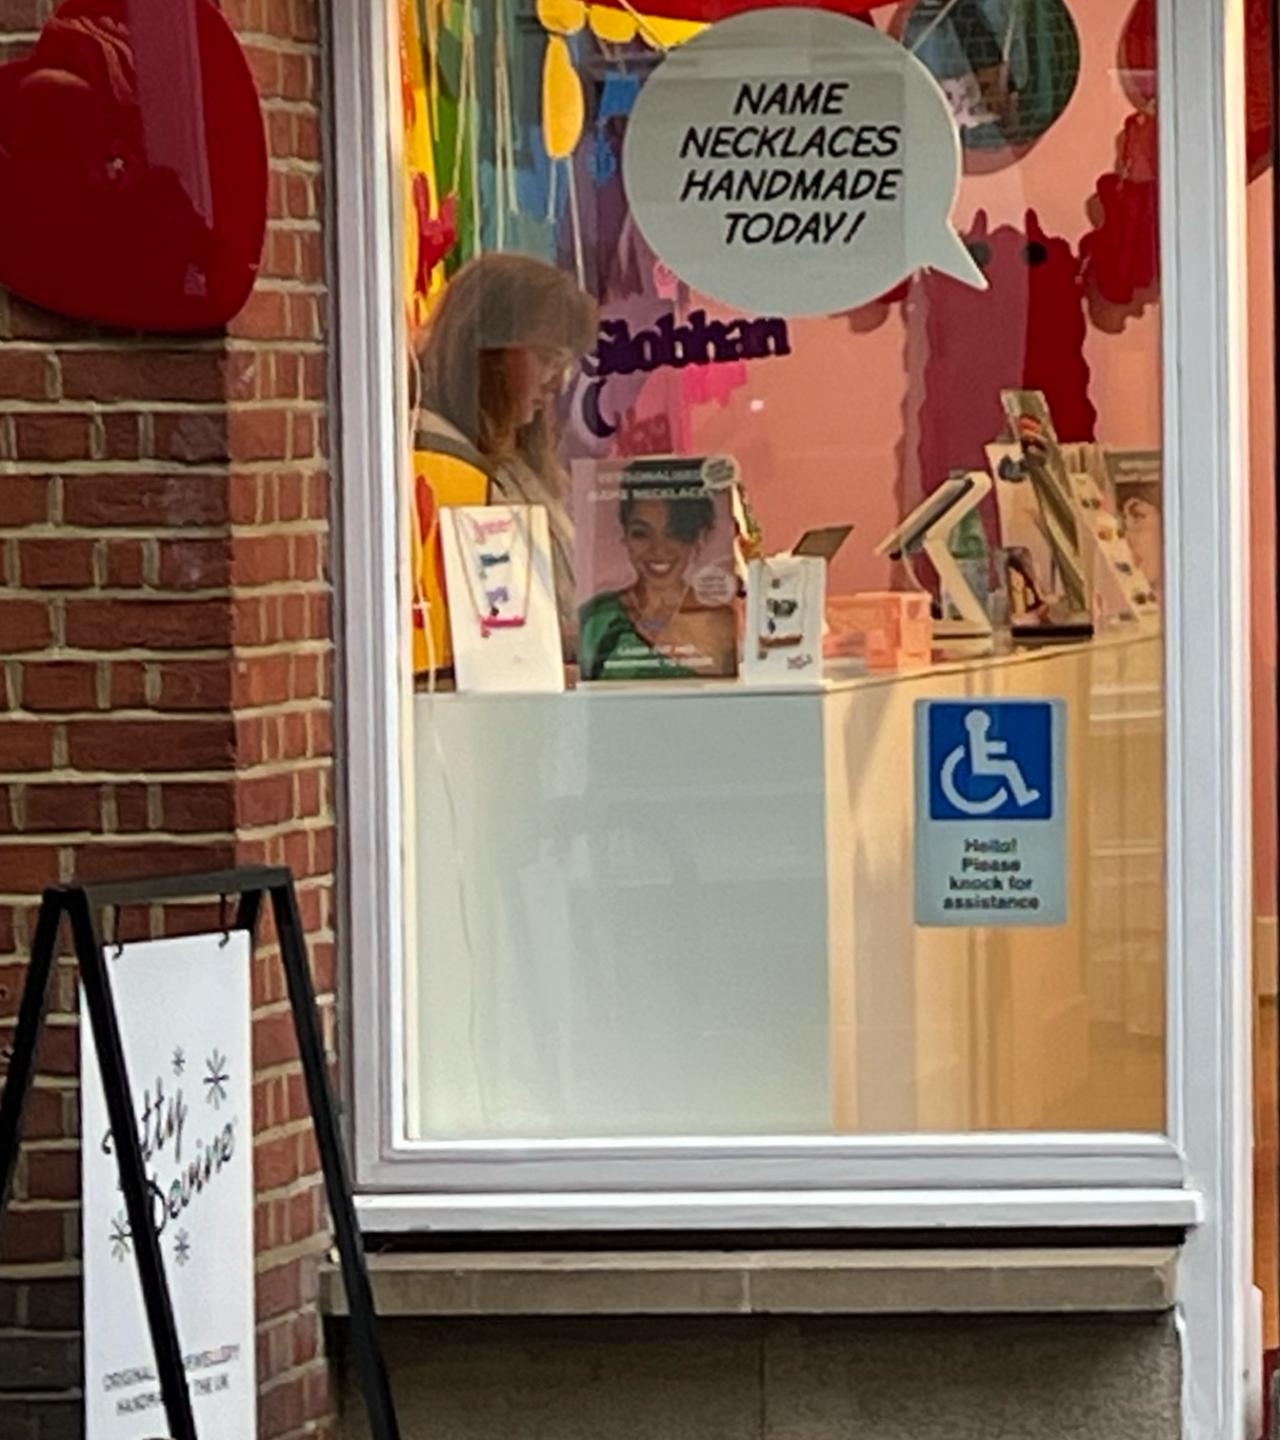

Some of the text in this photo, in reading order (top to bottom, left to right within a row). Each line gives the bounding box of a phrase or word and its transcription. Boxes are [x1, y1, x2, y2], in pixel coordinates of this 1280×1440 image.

[733, 81, 850, 115] NAME
[679, 125, 902, 159] NECKLACES
[680, 168, 903, 202] HANDMADE
[725, 211, 867, 244] TODAY!
[964, 838, 1018, 853] Hello!
[961, 857, 1021, 872] Please
[948, 874, 1033, 891] knock for
[943, 893, 1040, 910] assistance
